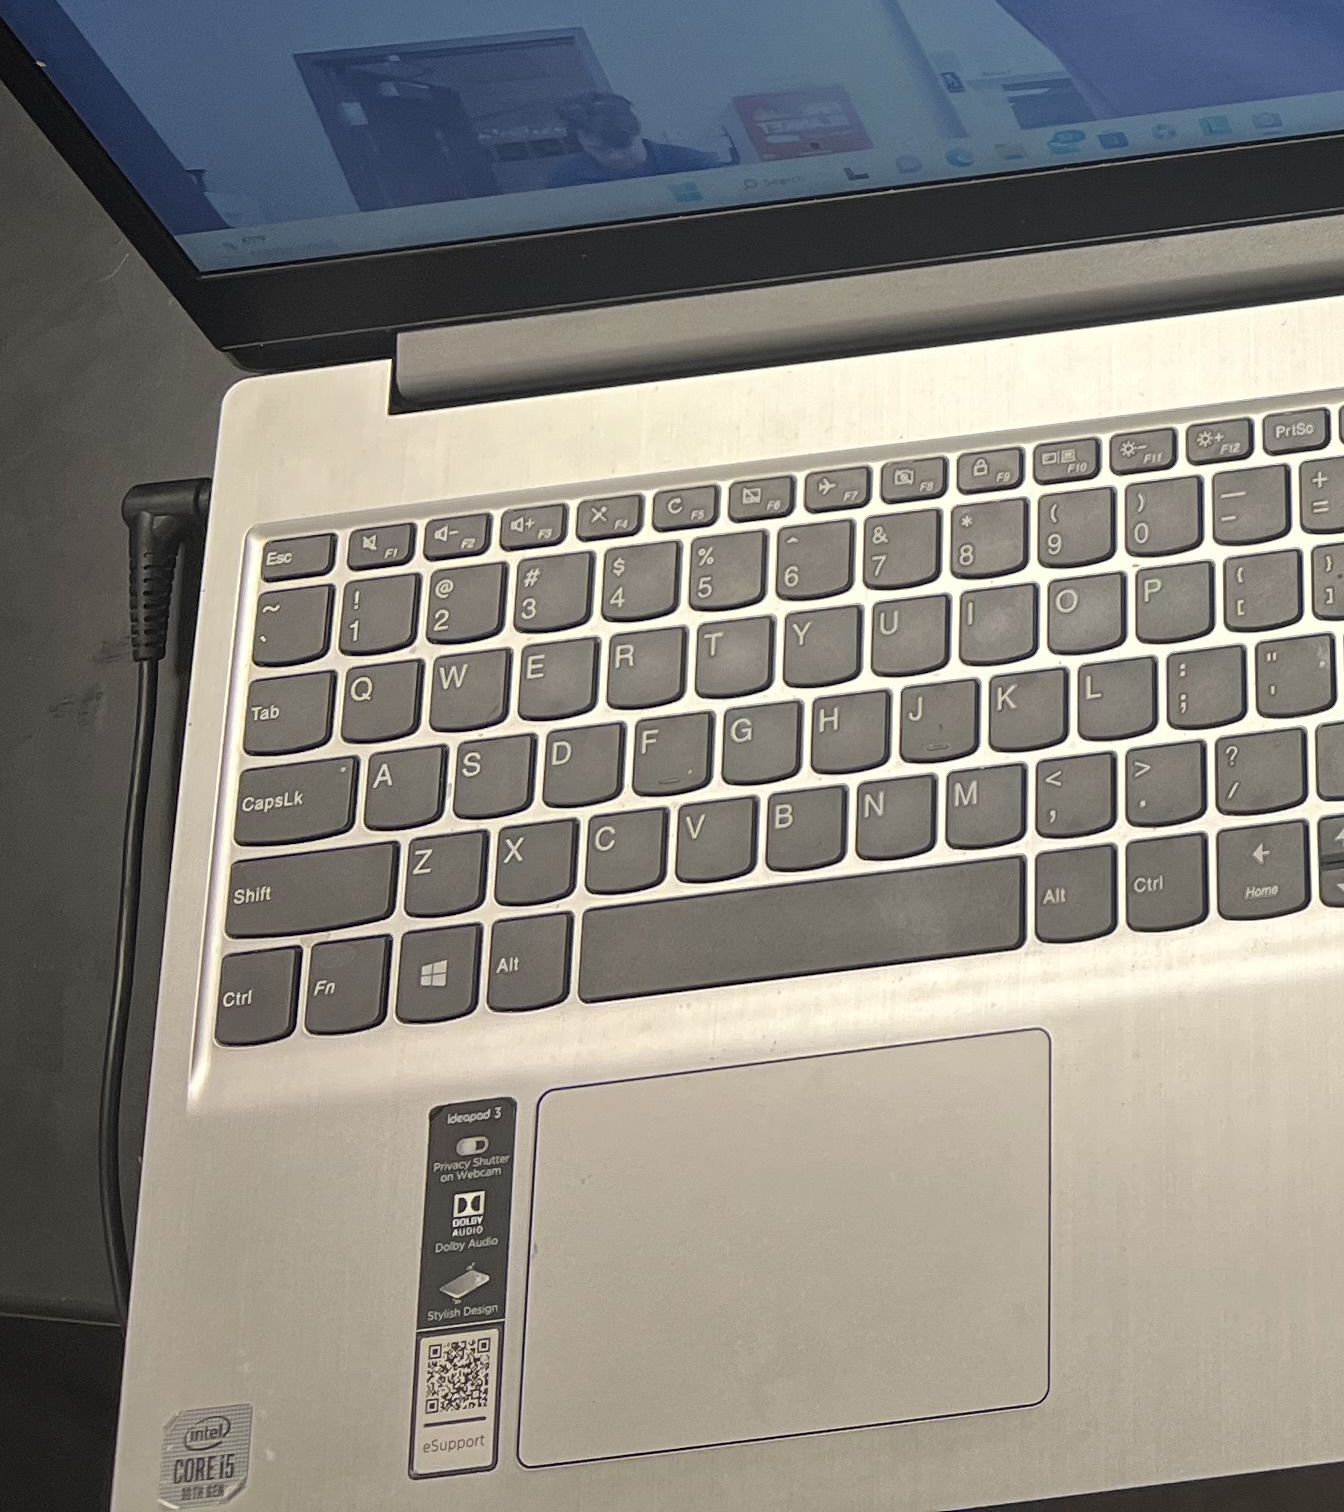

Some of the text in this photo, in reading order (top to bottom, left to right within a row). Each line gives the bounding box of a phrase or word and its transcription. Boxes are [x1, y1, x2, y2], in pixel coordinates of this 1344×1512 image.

[1275, 422, 1314, 439] PrtSc
[1219, 442, 1241, 455] F12
[1067, 462, 1088, 474] F10
[690, 509, 705, 520] F5
[266, 551, 293, 566] Esc
[251, 704, 280, 721] Tab
[241, 790, 303, 813] CapsLk
[1133, 875, 1163, 893] Ctrl
[1245, 885, 1279, 898] Home
[233, 885, 271, 905] Shift
[1043, 887, 1066, 904] Alt
[496, 956, 519, 974] Alt
[313, 979, 336, 997] Fn
[222, 989, 253, 1008] Ctrl
[494, 1107, 502, 1119] 3
[433, 1153, 510, 1173] Privacy Shutter
[440, 1166, 501, 1182] on Webcam
[452, 1217, 483, 1228] DOLBY
[452, 1225, 483, 1237] AUDIO
[435, 1236, 499, 1254] Dolby Audio
[427, 1303, 498, 1322] Stylish Design
[190, 1423, 223, 1442] intel
[423, 1434, 485, 1454] eSupport
[173, 1453, 235, 1484] CORE i5
